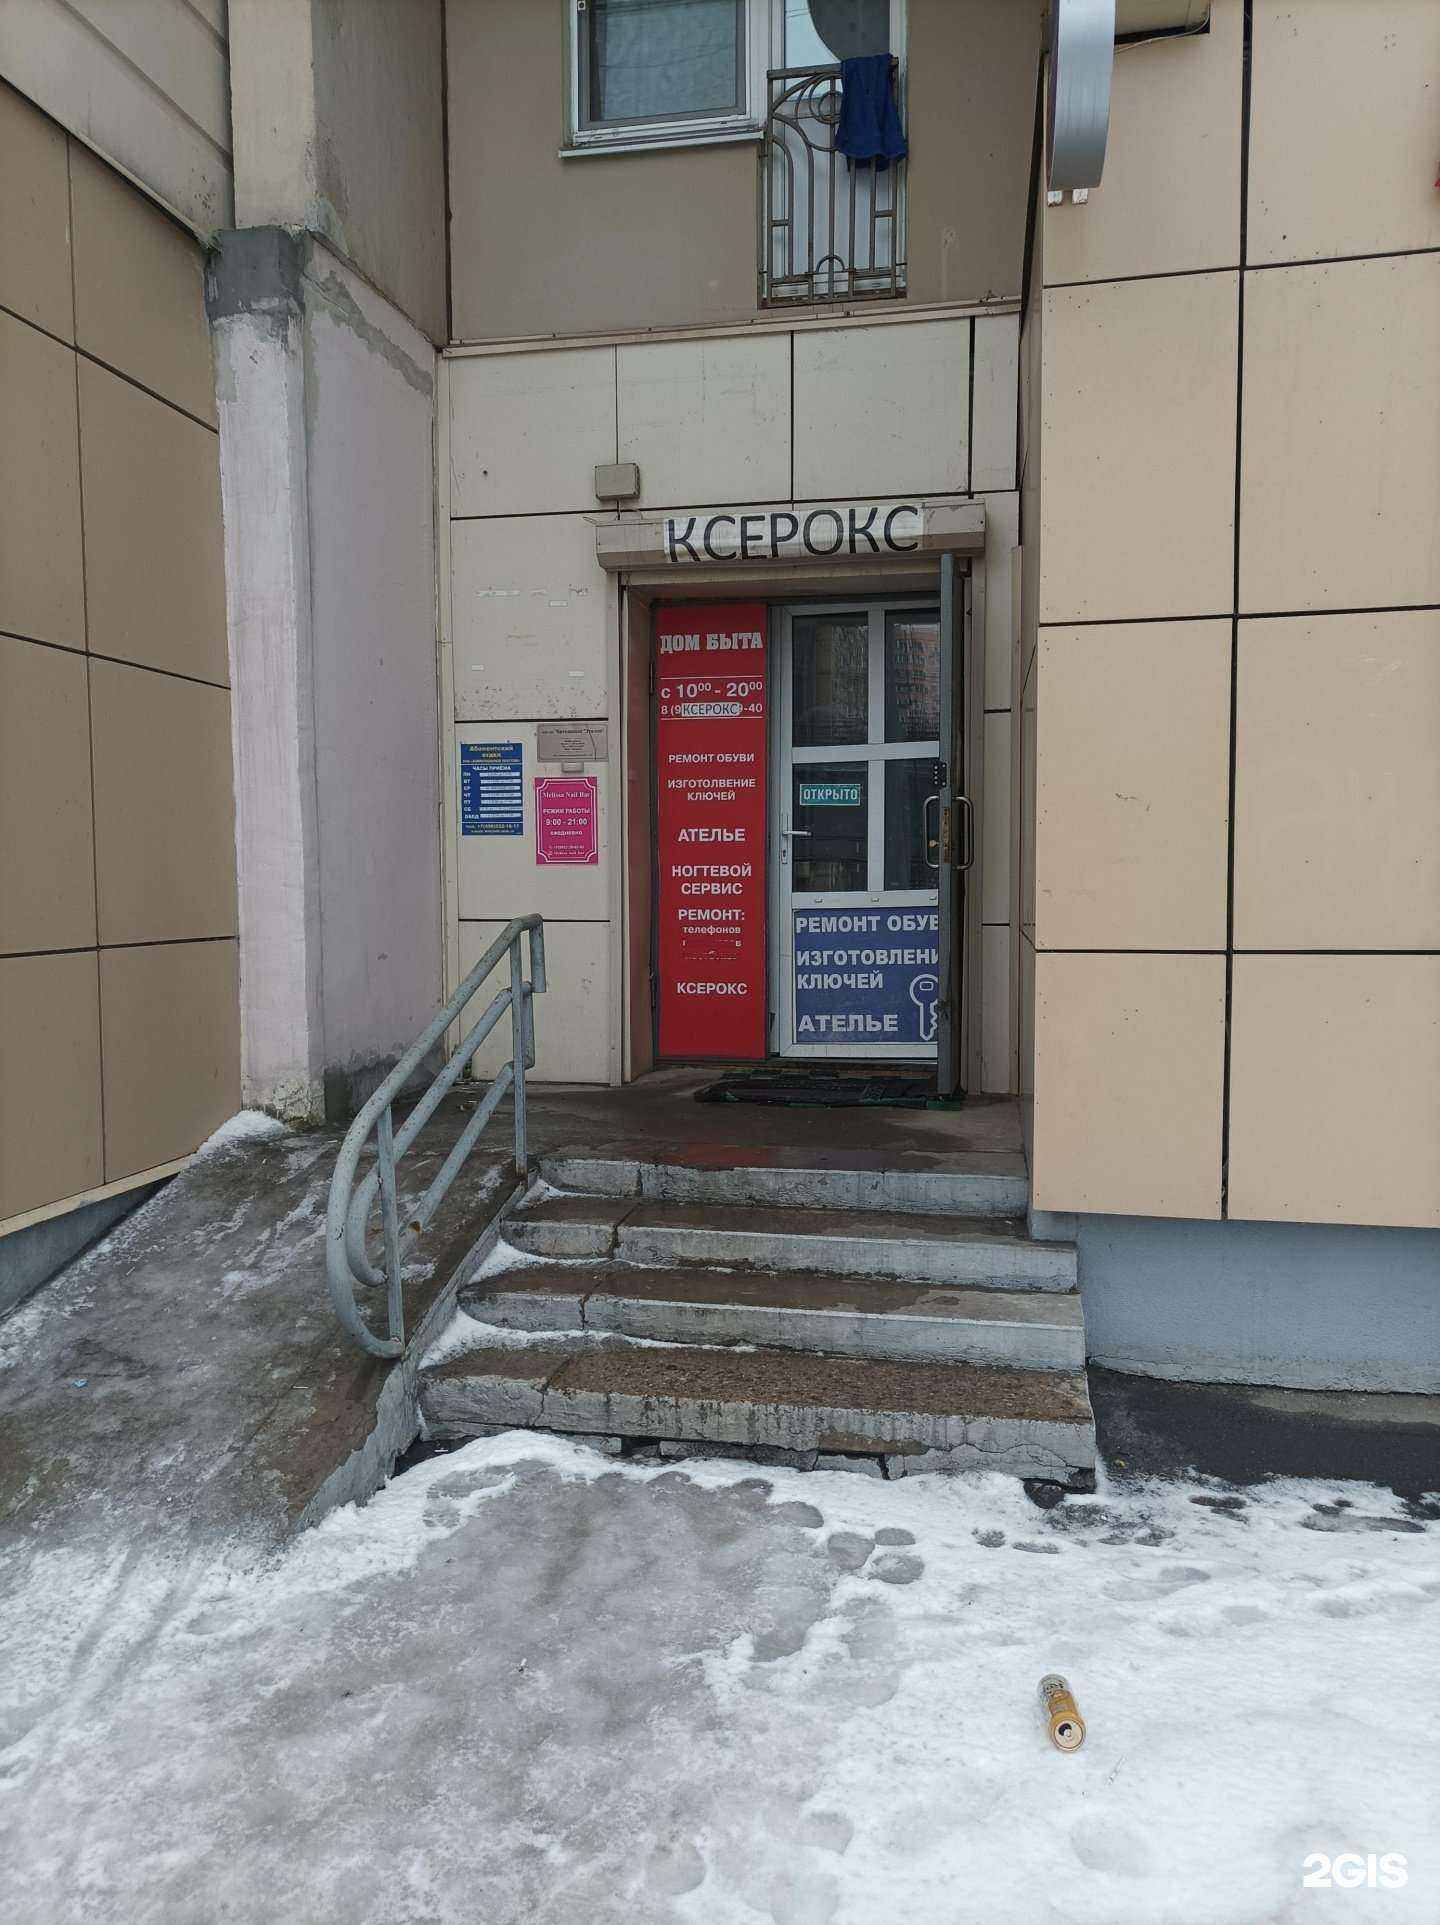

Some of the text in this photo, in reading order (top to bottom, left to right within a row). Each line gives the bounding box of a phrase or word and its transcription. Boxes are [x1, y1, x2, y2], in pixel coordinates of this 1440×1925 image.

[667, 505, 919, 562] КСЕРОКС
[660, 632, 764, 654] ДОМ БЫТА
[683, 703, 739, 715] КСЕРОКС
[668, 752, 755, 764] РЕМОНТ ОБУВИ
[687, 790, 736, 801] КЛЮЧЕЙ
[803, 788, 858, 801] ОТКРЫТО
[678, 828, 746, 842] АТЕЛЬЕ
[672, 862, 752, 877] НОГТЕВОЙ
[681, 882, 744, 895] СЕРВИС
[678, 909, 745, 921] РЕМОНТ:
[682, 925, 741, 936] телефонов
[796, 916, 881, 933] РЕМОНТ
[797, 969, 883, 990] КЛЮЧЕЙ
[676, 982, 748, 994] КСЕРОКС
[798, 1014, 899, 1032] АТЕЛЬЕ
